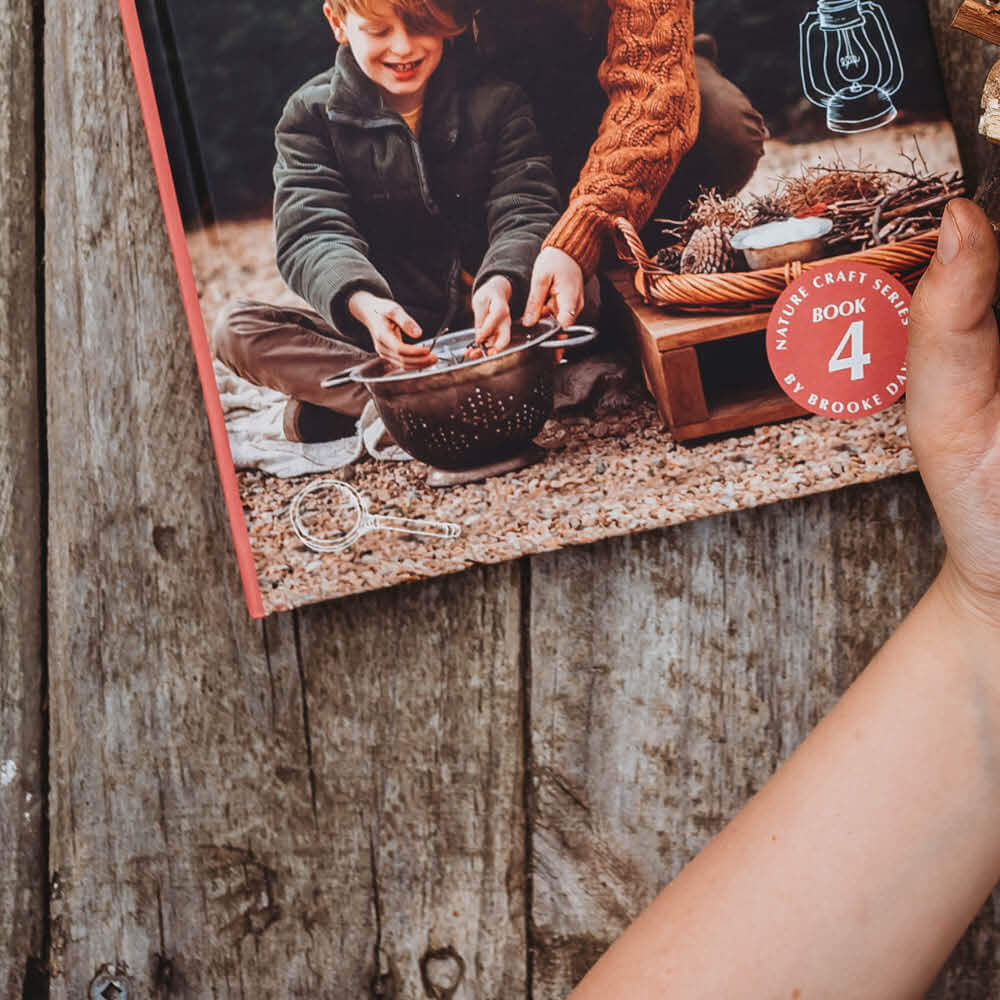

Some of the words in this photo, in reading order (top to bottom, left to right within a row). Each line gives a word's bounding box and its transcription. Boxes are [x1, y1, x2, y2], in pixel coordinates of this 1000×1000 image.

[775, 286, 809, 350] NATURE
[812, 270, 868, 289] CRAFT
[872, 278, 911, 327] SERIES
[812, 297, 867, 323] BOOK
[828, 319, 872, 381] 4
[783, 373, 805, 394] BY
[807, 393, 883, 414] BROOKE
